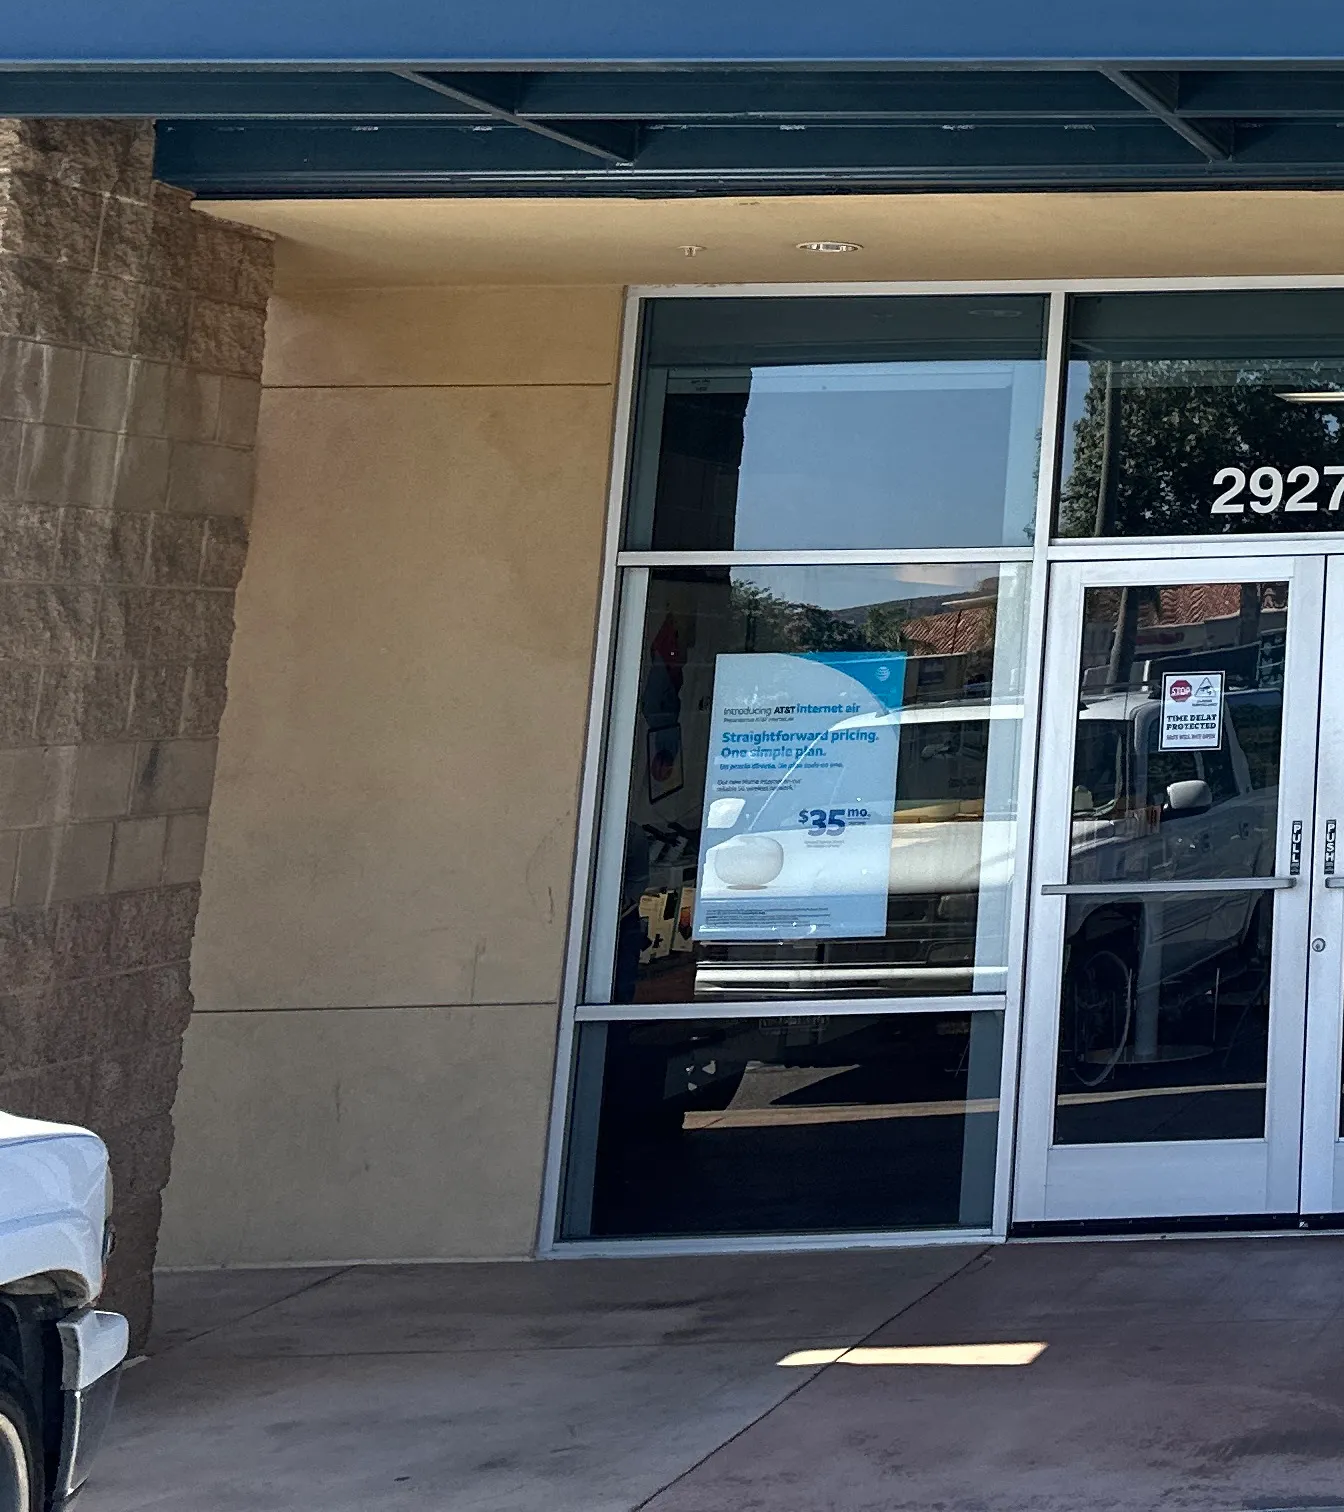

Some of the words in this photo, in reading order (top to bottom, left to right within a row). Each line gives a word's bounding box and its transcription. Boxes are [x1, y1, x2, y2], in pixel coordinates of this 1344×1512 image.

[1170, 686, 1190, 698] STOP
[774, 705, 795, 715] AT&T
[1189, 713, 1217, 722] DELAY
[1166, 722, 1217, 730] PROTECTED
[721, 730, 829, 746] Straightforward
[831, 729, 880, 743] pricing.
[720, 747, 747, 758] One
[795, 745, 827, 760] plan.
[1291, 824, 1302, 863] PULL
[1325, 823, 1336, 862] PUSH
